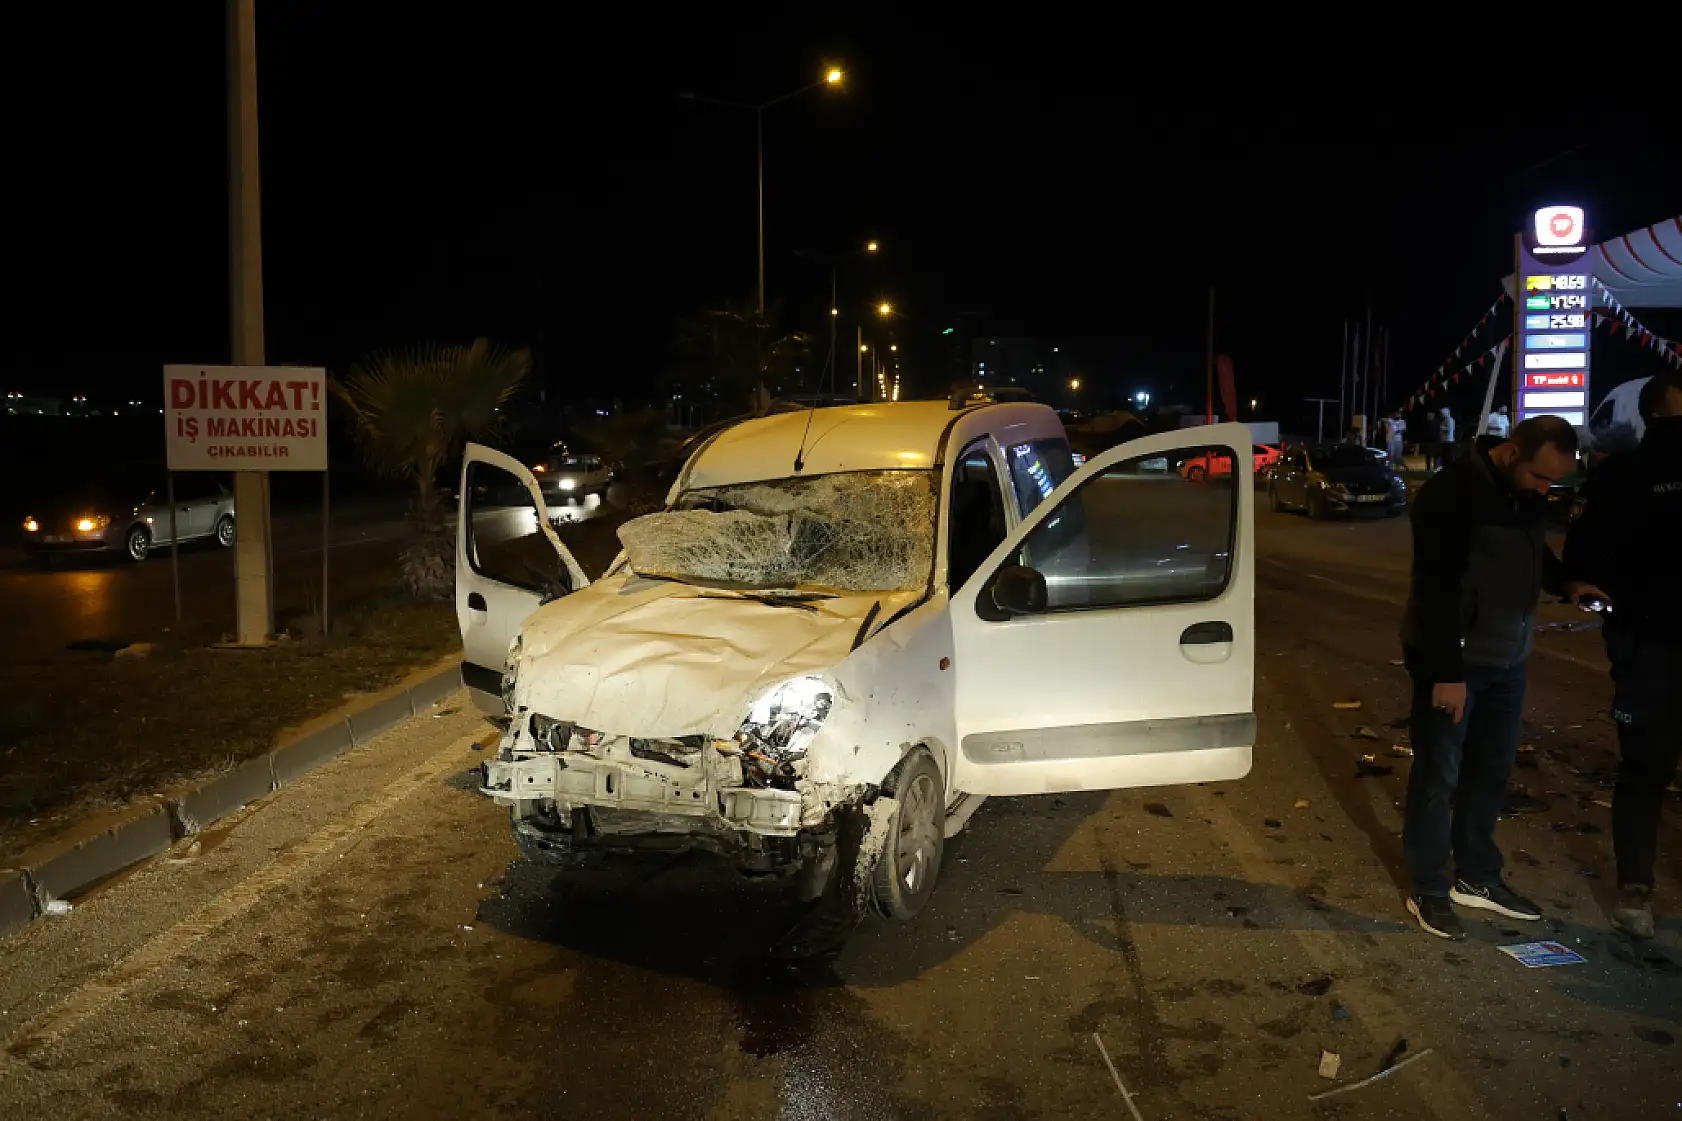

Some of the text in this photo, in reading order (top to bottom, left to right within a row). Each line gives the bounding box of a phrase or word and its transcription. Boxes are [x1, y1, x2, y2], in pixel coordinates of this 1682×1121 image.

[170, 370, 320, 411] DİKKAT!
[177, 412, 317, 443] İŞ MAKİNASI
[207, 444, 289, 459] ÇIKABİLİR
